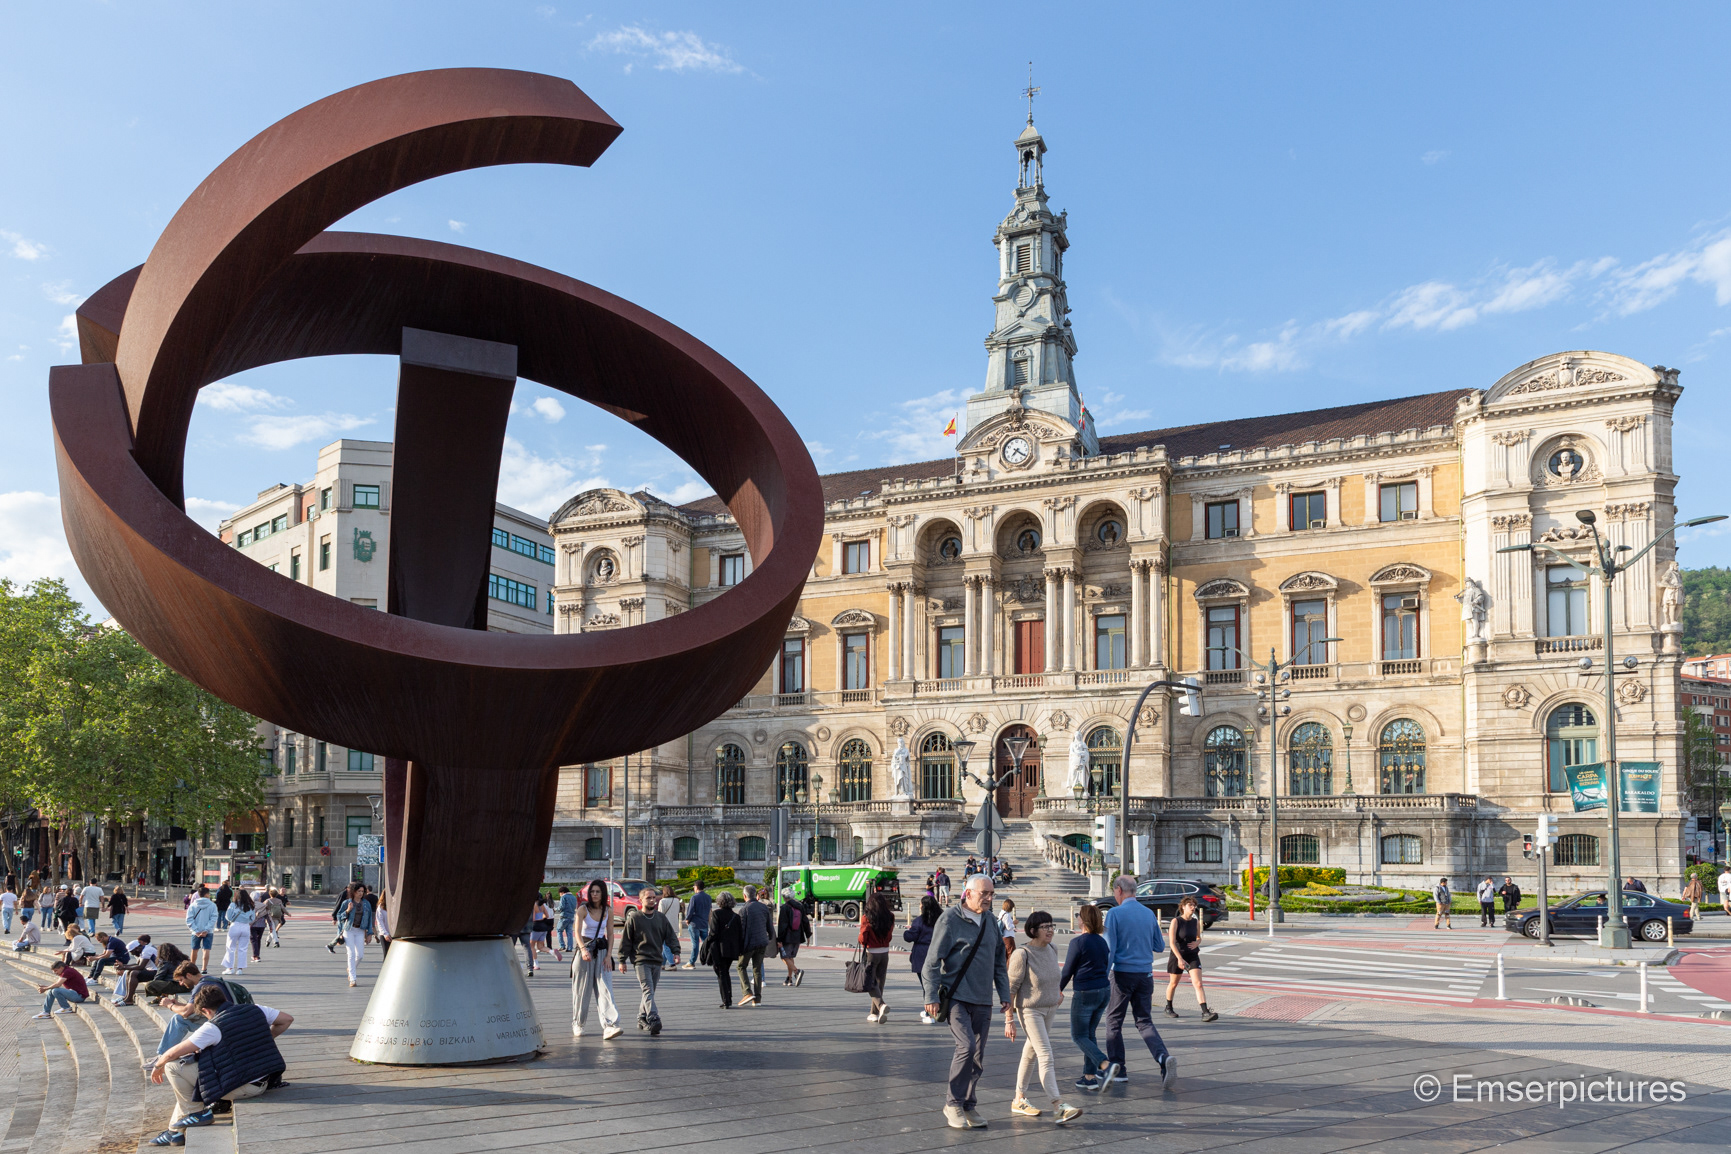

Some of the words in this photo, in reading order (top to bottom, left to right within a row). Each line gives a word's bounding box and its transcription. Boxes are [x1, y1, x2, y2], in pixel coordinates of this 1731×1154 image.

[486, 1012, 511, 1024] JORGE
[401, 1037, 434, 1046] BILBAO
[439, 1036, 476, 1046] BIZKAIA
[496, 1028, 528, 1040] VARIANTE
